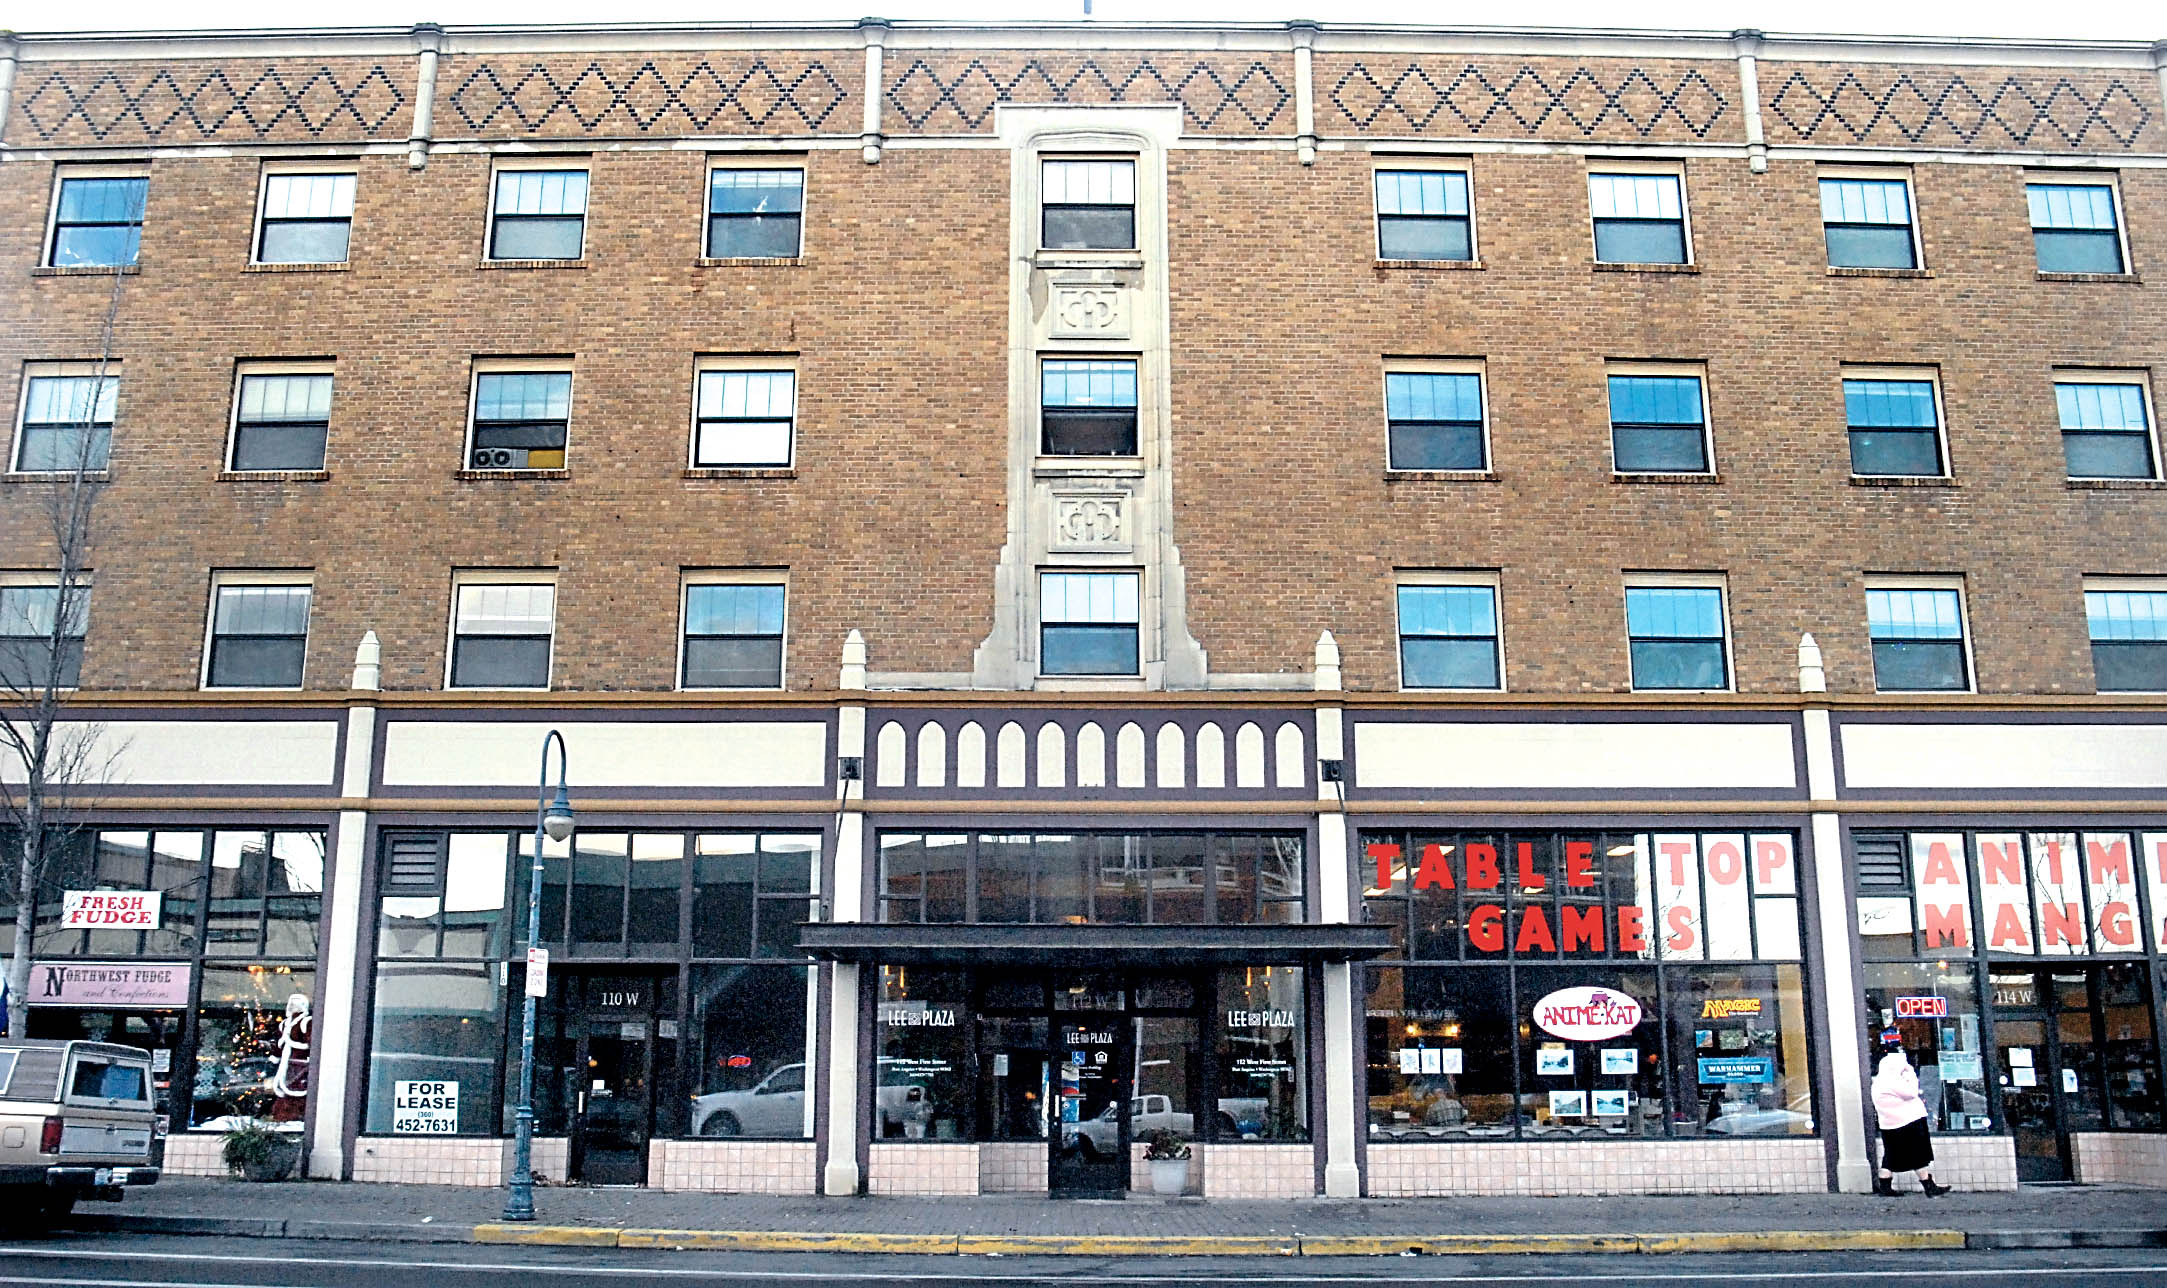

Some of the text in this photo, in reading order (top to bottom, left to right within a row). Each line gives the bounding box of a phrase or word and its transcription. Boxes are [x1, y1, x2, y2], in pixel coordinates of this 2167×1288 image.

[1367, 841, 1787, 889] TABLE TOP
[80, 896, 144, 910] FRESH
[70, 910, 151, 924] FUDGE
[1468, 905, 1696, 952] GAMES
[1924, 901, 2167, 948] MANG
[135, 970, 171, 983] FUDGE
[601, 992, 639, 1006] 110 W
[1997, 991, 2032, 1003] 114 W
[1701, 998, 1761, 1019] MAGIC
[1898, 999, 1945, 1016] OPEN
[888, 1010, 955, 1026] LEE PLAZA
[1228, 1010, 1295, 1027] LEE PLAZA
[1067, 1033, 1113, 1044] LEE PLAZA
[1708, 1064, 1760, 1073] WARHAMMER
[408, 1083, 445, 1095] FOR
[397, 1097, 456, 1109] LEASE
[396, 1119, 455, 1131] 452-7631
